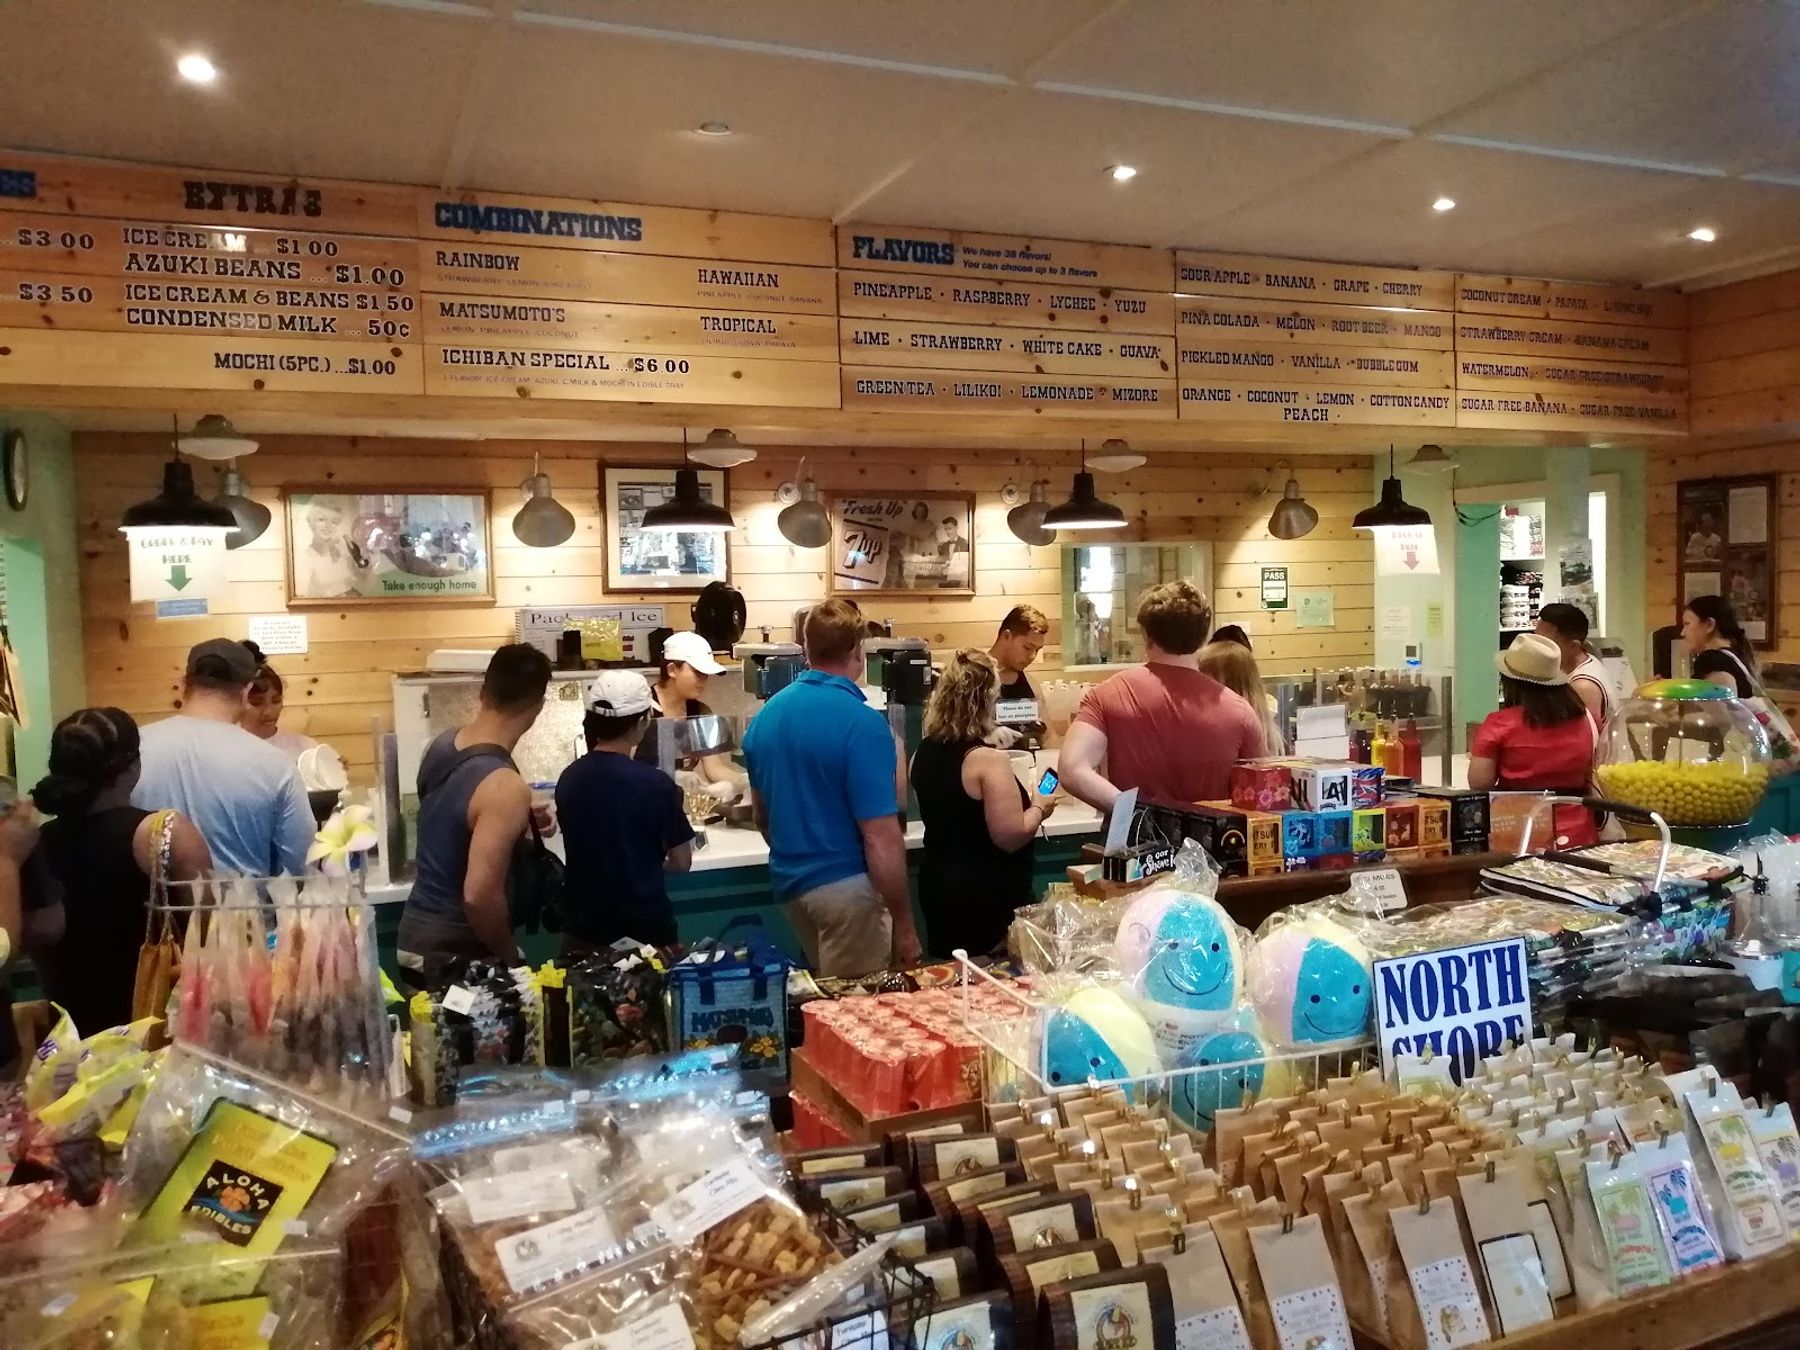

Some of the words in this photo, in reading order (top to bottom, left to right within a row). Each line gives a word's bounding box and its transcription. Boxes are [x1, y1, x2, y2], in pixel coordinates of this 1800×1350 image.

[435, 202, 642, 241] COMBINATIONS
[123, 228, 158, 246] ICE
[164, 231, 247, 252] CREAM
[436, 251, 520, 271] RAINBOW
[853, 236, 954, 266] FLAVORS
[963, 246, 977, 256] We
[979, 246, 1001, 257] have
[1005, 249, 1016, 259] 38
[125, 253, 208, 275] AZUKI
[215, 257, 300, 280] BEANS
[336, 265, 404, 286] $1.00
[963, 259, 979, 269] You
[981, 262, 999, 271] can
[1001, 262, 1033, 272] choose
[1036, 265, 1047, 275] up
[1049, 265, 1057, 274] to
[1060, 266, 1066, 275] 3
[1068, 267, 1098, 277] flavors
[698, 269, 779, 288] HAWAIIAN
[1181, 268, 1211, 281] SOUR
[1214, 271, 1250, 284] APPLE
[1265, 274, 1316, 290] BANANA
[1334, 279, 1369, 293] GRAPE
[1383, 282, 1423, 297] CHERRY
[125, 284, 161, 300] ICE
[166, 286, 248, 305] CREAM
[253, 290, 270, 305] &
[276, 290, 350, 309] BEANS
[356, 293, 414, 312] $1.50
[853, 282, 932, 300] PINEAPPLE
[953, 288, 1031, 306] RASPBERRY
[1050, 295, 1096, 311] LYCHEE
[1115, 300, 1147, 313] YUZU
[1461, 289, 1506, 303] COCONUT
[1507, 291, 1541, 306] CREAM
[126, 308, 272, 330] CONDENSED
[278, 314, 337, 334] MILK
[439, 302, 565, 323] MATSUMOTO'S
[700, 316, 776, 334] TROPICAL
[1213, 314, 1260, 328] COLADA
[1276, 317, 1315, 330] MELON
[1331, 320, 1359, 332] ROOT
[1362, 321, 1388, 334] BEER
[1404, 325, 1441, 337] MANGO
[854, 331, 890, 346] LIME
[911, 333, 1002, 351] STRAWBERRY
[1023, 339, 1063, 354] WHITE
[1067, 342, 1102, 356] CAKE
[1120, 345, 1159, 359] GUAVA
[1460, 326, 1526, 342] STRAWBERRY
[1528, 330, 1562, 345] CREAM
[214, 352, 274, 371] MOCHI
[443, 349, 525, 367] ICHIBAN
[530, 353, 610, 370] SPECIAL
[634, 357, 690, 374] $6.00
[1181, 351, 1230, 365] PICKLED
[1232, 353, 1274, 366] MANGO
[1292, 355, 1341, 369] VANILLA
[1462, 362, 1529, 377] WATERMELON
[857, 380, 904, 394] GREEN
[907, 382, 935, 395] TEA
[954, 384, 1001, 397] LILIKOI
[1022, 385, 1094, 400] LEMONADE
[1112, 388, 1158, 402] MIZORE
[1182, 388, 1231, 402] ORANGE
[1247, 390, 1299, 404] COCONUT
[1317, 393, 1354, 405] LEMON
[1283, 408, 1329, 421] PEACH
[1461, 398, 1494, 411] SUGAR
[1498, 400, 1522, 412] FREE
[1525, 402, 1567, 414] BANANA
[1579, 404, 1609, 416] SUGAR
[382, 580, 405, 591] Take
[409, 580, 446, 593] enough
[449, 579, 477, 590] home
[1264, 572, 1284, 580] PASS
[631, 611, 657, 622] Ice
[1380, 944, 1525, 1028] NORTH
[206, 1173, 269, 1210] ALOHA
[191, 1205, 251, 1235] EDIBLES
